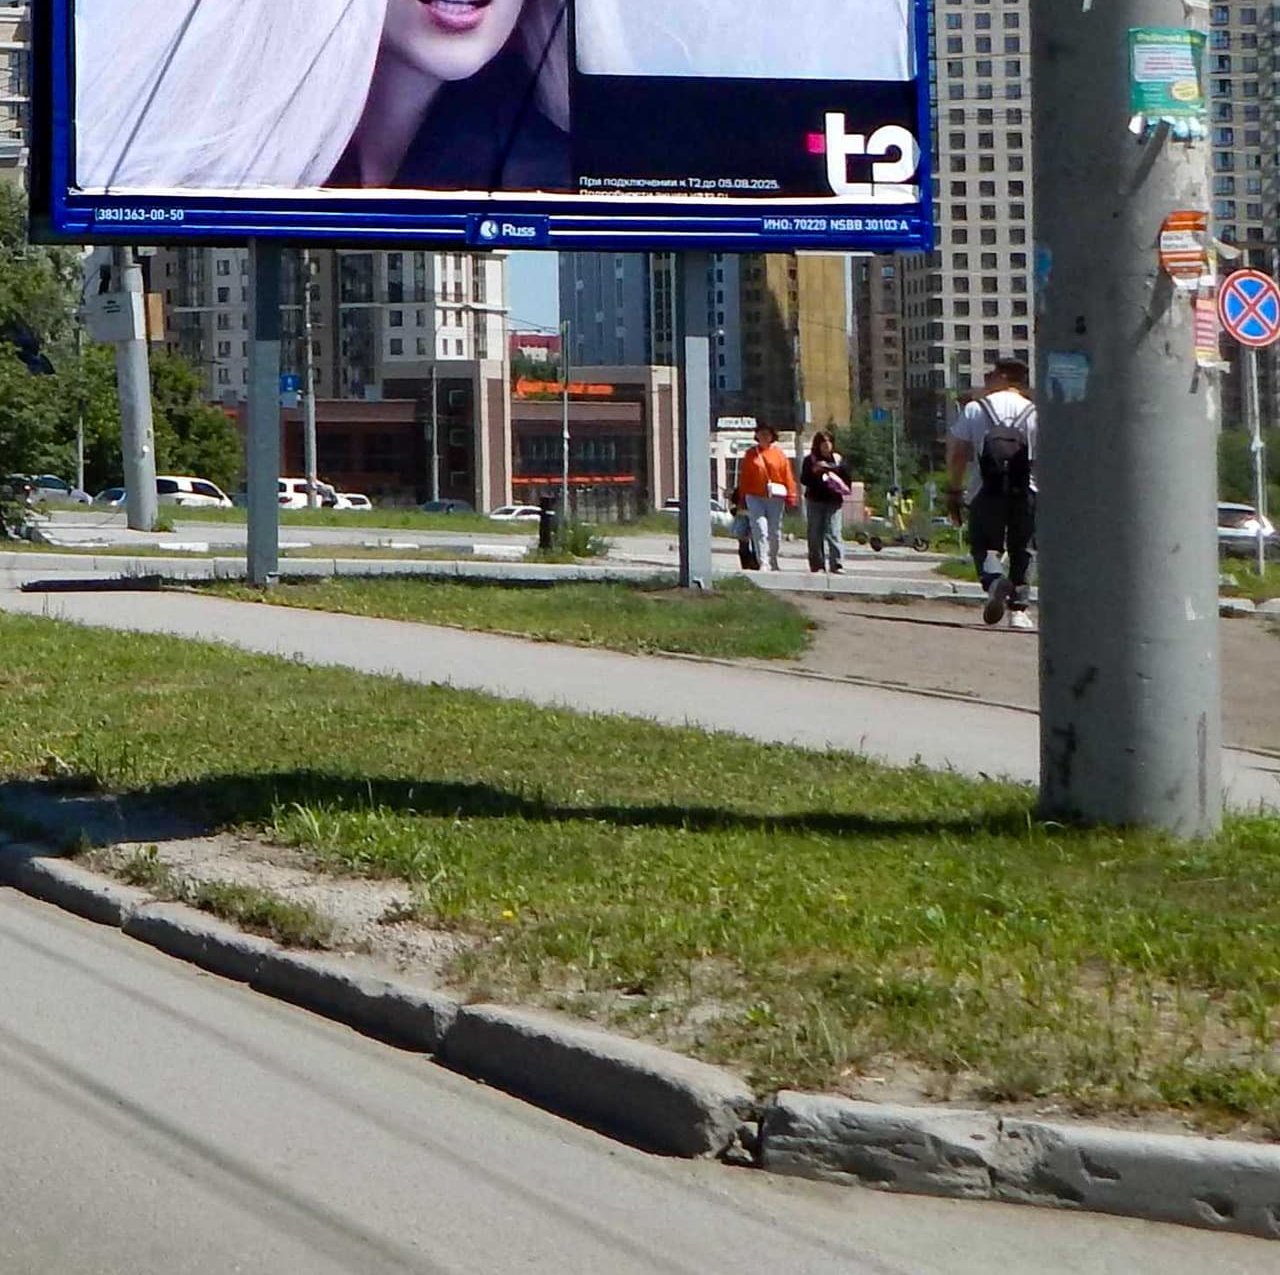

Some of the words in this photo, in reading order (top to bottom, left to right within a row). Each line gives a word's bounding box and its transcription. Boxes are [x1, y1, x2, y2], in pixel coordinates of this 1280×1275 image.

[579, 176, 602, 187] При
[603, 177, 678, 188] подключении
[679, 178, 687, 187] к
[701, 179, 717, 189] до
[502, 223, 537, 237] Russ
